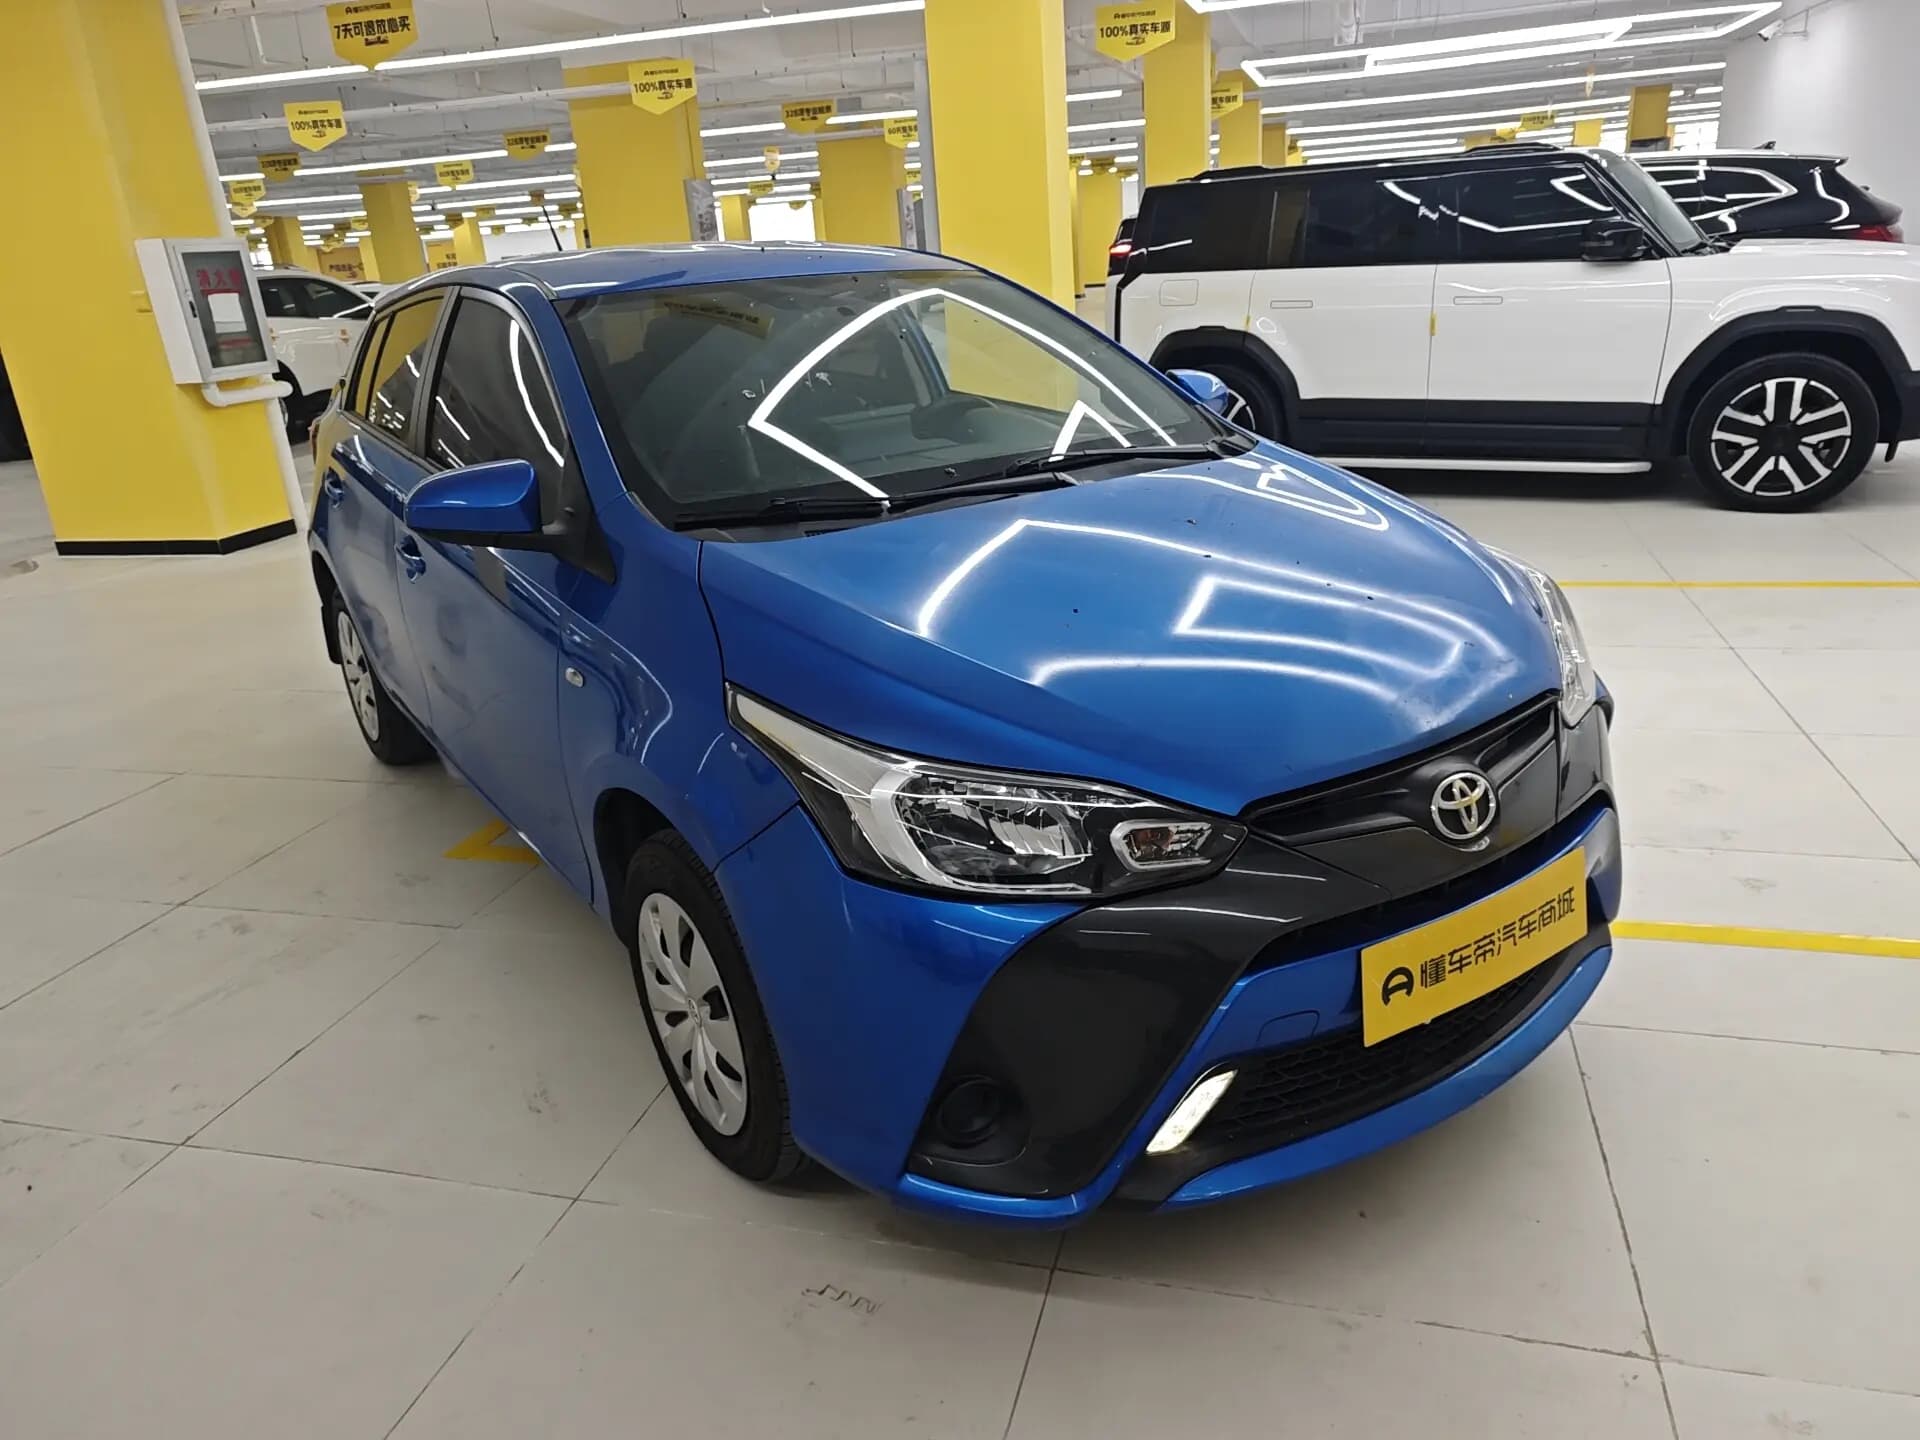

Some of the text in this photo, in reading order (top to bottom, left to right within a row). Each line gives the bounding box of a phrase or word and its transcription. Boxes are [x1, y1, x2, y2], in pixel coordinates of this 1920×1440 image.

[1420, 886, 1575, 988] 懂车帝汽车商城
